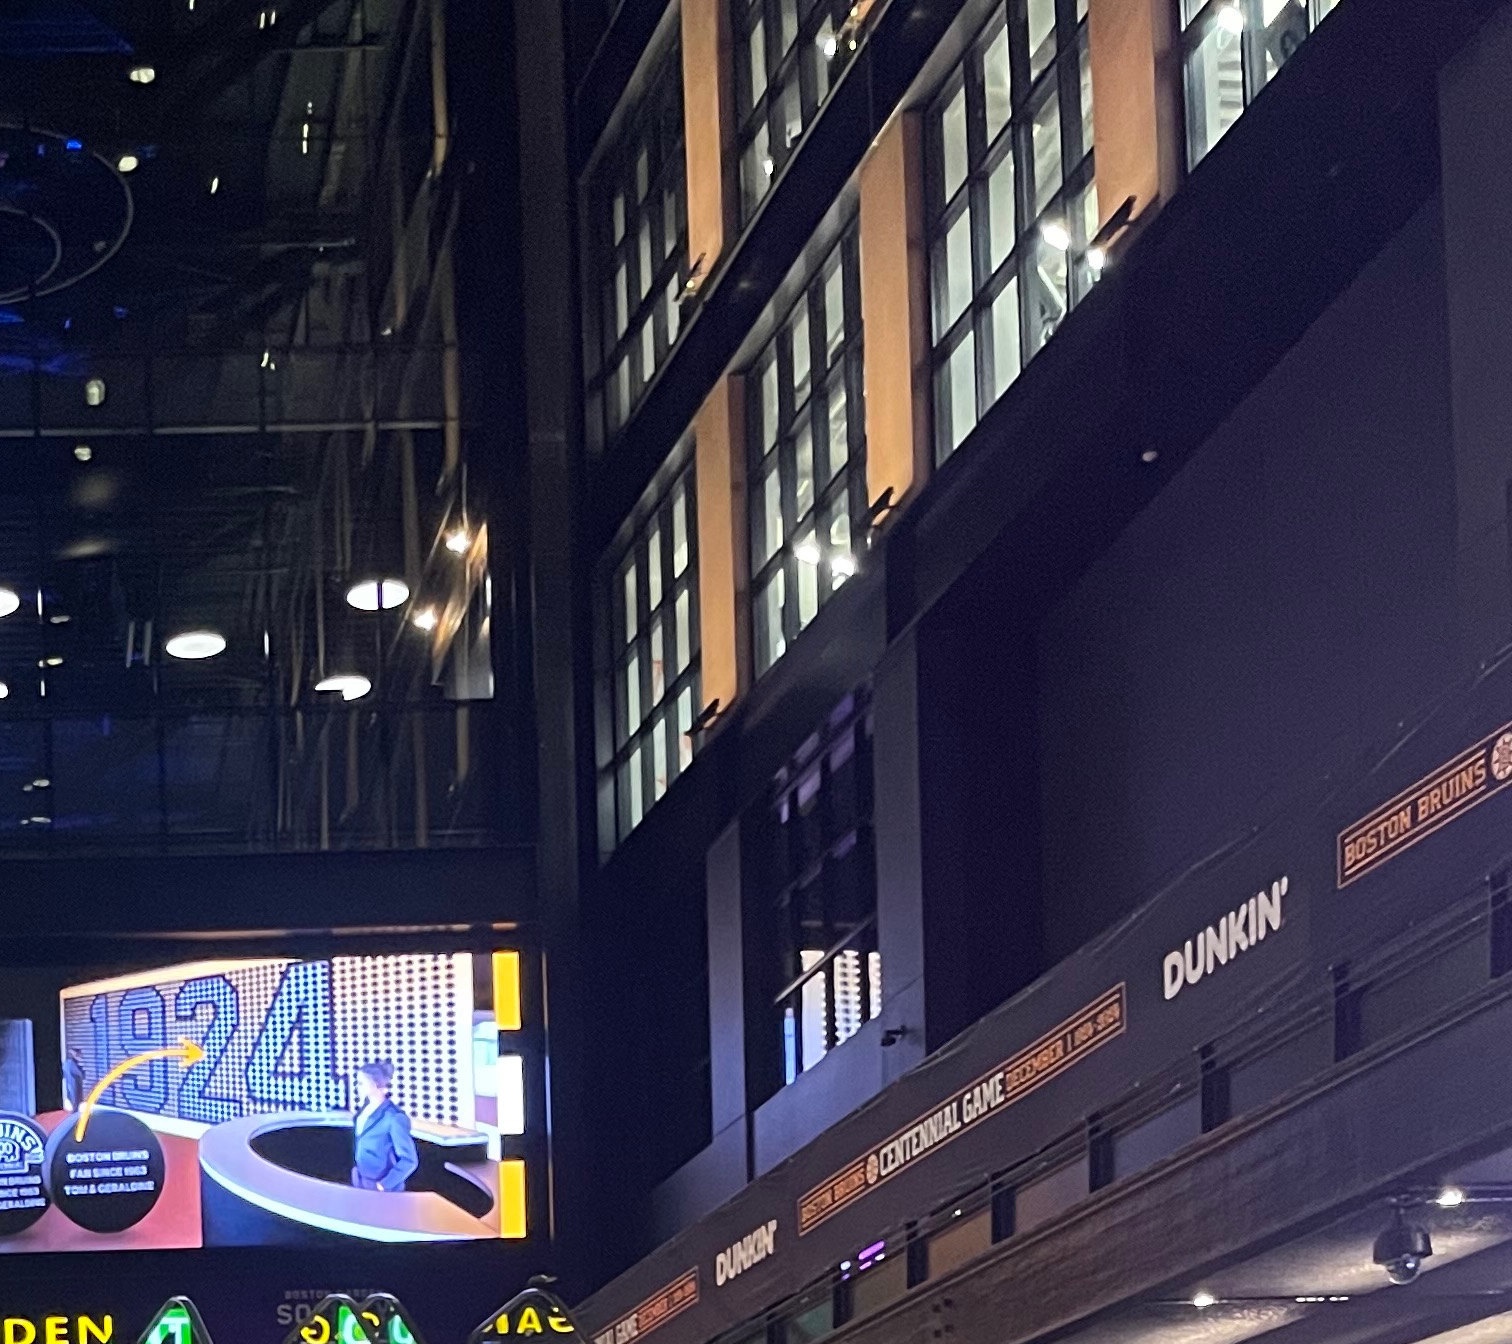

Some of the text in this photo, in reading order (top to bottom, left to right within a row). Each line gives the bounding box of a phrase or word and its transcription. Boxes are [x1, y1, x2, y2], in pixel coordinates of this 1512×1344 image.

[1344, 758, 1486, 868] BOSTON BRUINS
[1163, 875, 1288, 1000] DUNKIN'
[90, 960, 350, 1124] 1924
[879, 1102, 961, 1177] CENTENNIAL
[962, 1071, 1005, 1124] GAME
